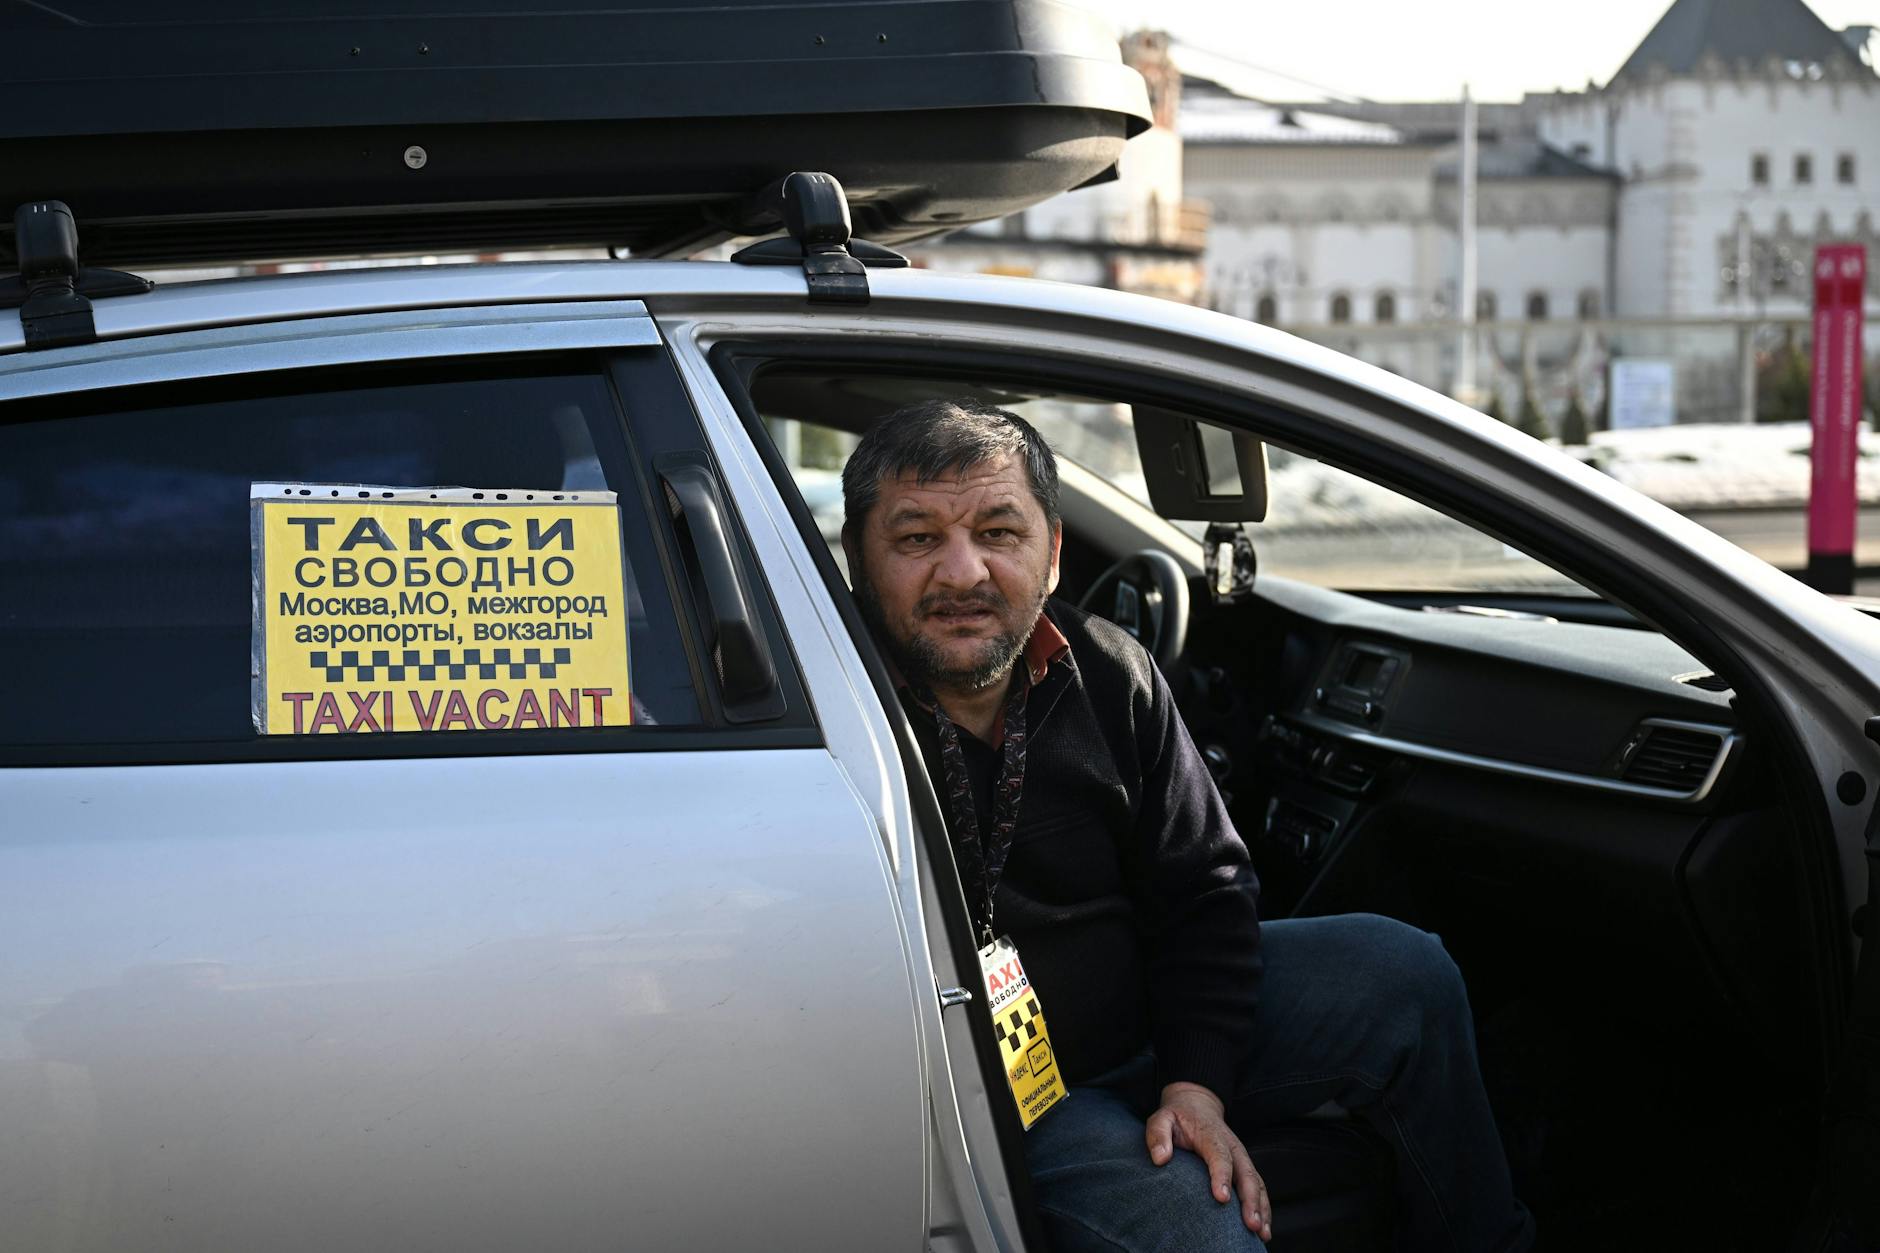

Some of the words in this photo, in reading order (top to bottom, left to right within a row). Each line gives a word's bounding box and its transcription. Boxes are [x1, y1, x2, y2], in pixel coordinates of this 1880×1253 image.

[287, 517, 575, 551] ТАКСИ
[294, 556, 575, 593] СВОБОДНО
[467, 595, 608, 619] межгород
[295, 620, 463, 648] аэропорты,
[473, 620, 593, 641] вокзалы
[281, 689, 393, 735] TAXI
[408, 687, 613, 731] VACANT
[988, 958, 1023, 995] AXI
[990, 977, 1028, 1009] ВОБОДНО
[1009, 1062, 1030, 1082] Яндекс
[1031, 1050, 1048, 1066] Такси
[1021, 1074, 1058, 1108] ОФИЦИАЛЬНЫЙ
[1028, 1090, 1059, 1118] ПЕРЕВОЗЧИК
